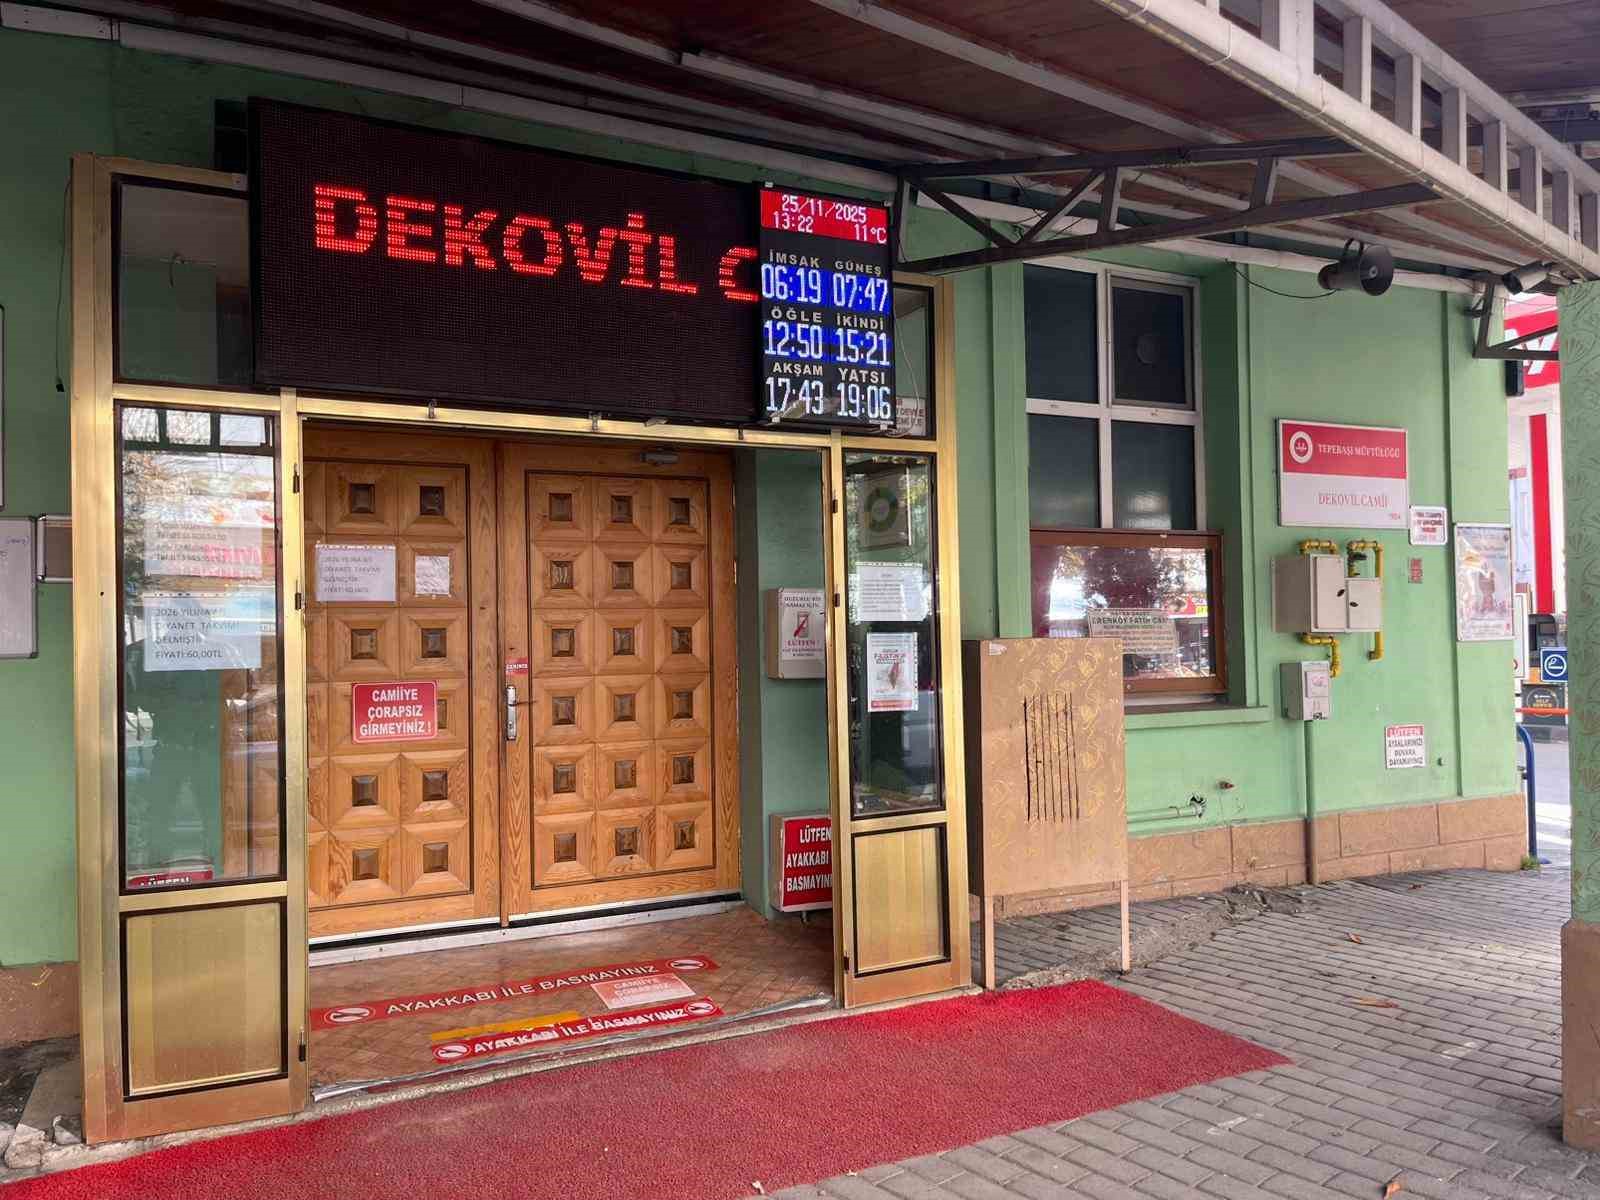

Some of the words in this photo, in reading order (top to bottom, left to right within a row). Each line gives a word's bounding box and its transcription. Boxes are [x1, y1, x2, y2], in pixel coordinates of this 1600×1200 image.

[781, 194, 867, 223] 25/11/2025
[773, 211, 814, 233] 13:22
[315, 186, 697, 294] DEKOVİL
[769, 248, 820, 268] İMSAK
[834, 259, 882, 276] GÜNEŞ
[761, 263, 822, 304] 06:19
[832, 272, 888, 312] 07:47
[771, 306, 823, 324] ÖĞLE
[836, 312, 884, 330] İKİNDİ
[763, 320, 823, 359] 12:50
[835, 329, 890, 365] 15:21
[772, 361, 823, 377] AKŞAM
[838, 367, 885, 384] YATSI
[765, 377, 824, 415] 17:43
[837, 382, 891, 419] 19:06
[155, 621, 195, 631] DYANET
[372, 686, 418, 702] CAMİİYE
[367, 705, 423, 722] ÇORAPSIZ
[360, 720, 426, 736] GİRMEYİNİZ
[800, 825, 832, 843] LÜTFEN
[786, 851, 829, 869] AYAKKABI
[386, 990, 497, 1015] AYAKKABI
[502, 986, 534, 999] İLE
[539, 965, 659, 991] BASMAYINIZ
[474, 1029, 559, 1053] AYAKKABI
[562, 1025, 589, 1037] İLE
